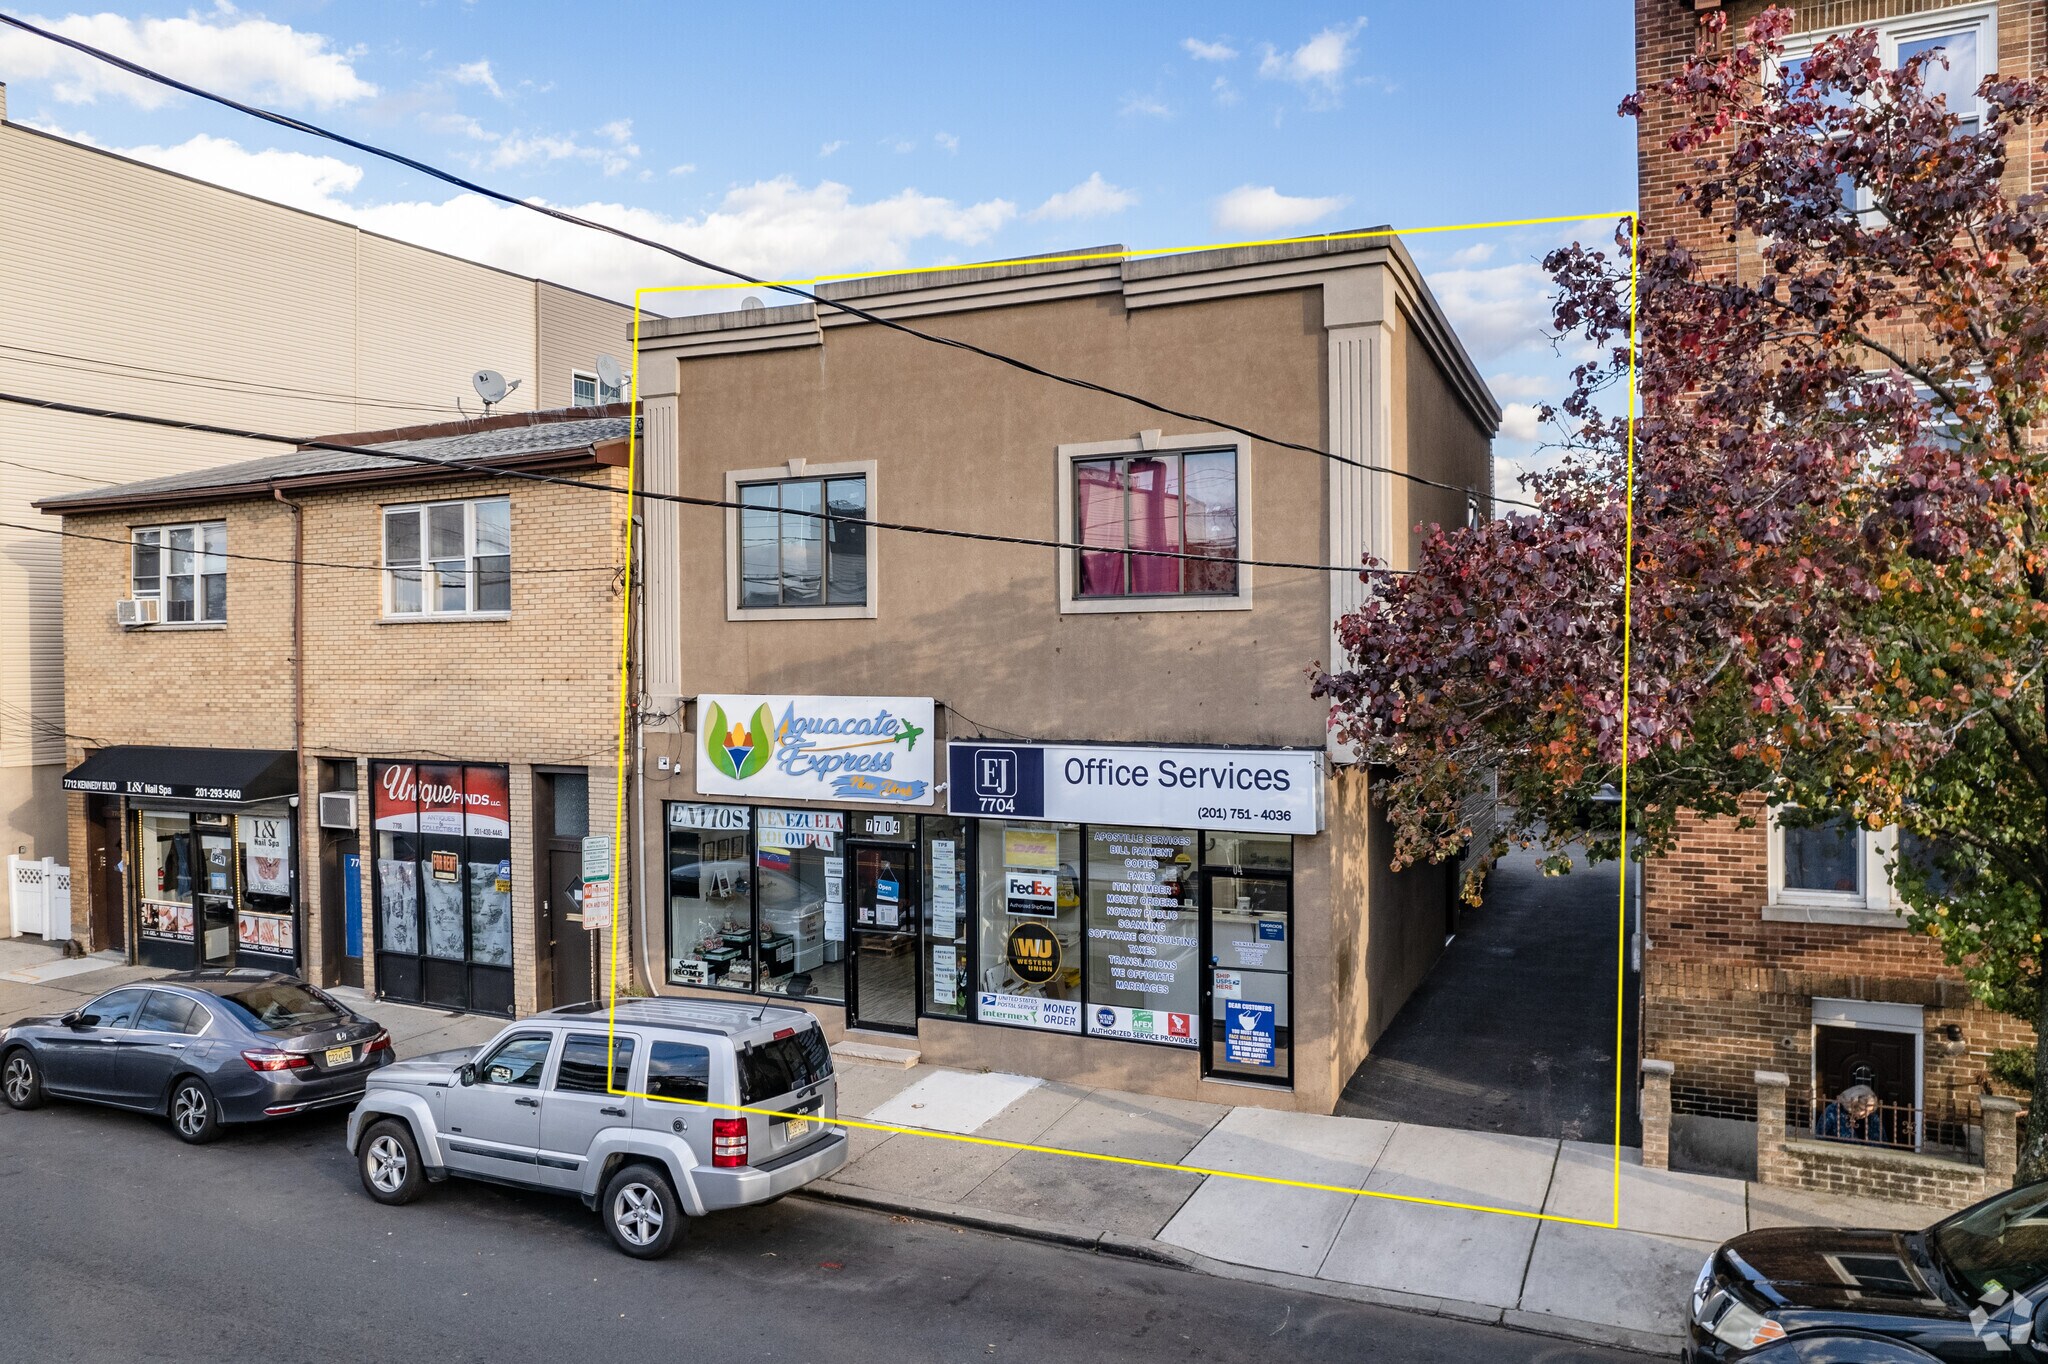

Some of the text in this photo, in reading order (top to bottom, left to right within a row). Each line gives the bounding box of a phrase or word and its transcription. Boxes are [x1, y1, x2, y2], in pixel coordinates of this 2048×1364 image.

[774, 700, 900, 745] Aguacate
[777, 741, 894, 782] Express
[981, 758, 1009, 793] EJ
[1064, 758, 1290, 791] Office Services
[64, 779, 117, 791] 7712 KENNEDY BLVD
[383, 765, 453, 809] Unique
[453, 794, 489, 805] FINDS
[850, 775, 875, 790] New
[145, 784, 157, 794] Nail
[158, 785, 172, 796] Spa
[195, 788, 241, 799] 201-293-5460
[979, 798, 1015, 812] 7704
[427, 814, 455, 822] ANTIQUES
[759, 809, 843, 830] VENEZUELA
[1198, 808, 1227, 821] (201)
[1231, 808, 1251, 820] 751
[1261, 810, 1291, 821] 4036
[422, 824, 461, 833] COLLECTIBLES
[474, 827, 503, 836] 201-430-4445
[866, 819, 900, 833] 7704
[254, 838, 279, 848] Nail Spa
[1094, 832, 1191, 845] APOSTILLE SERVICES
[1110, 845, 1174, 857] BILL PAYMENT
[1125, 858, 1158, 869] COPIES
[1127, 871, 1156, 881] FAXES
[878, 883, 892, 891] Open
[1010, 879, 1052, 896] FedEx
[1112, 882, 1171, 895] ITIN NUMBER
[1107, 894, 1178, 908] MONEY ORDERS
[1107, 907, 1178, 920] NOTARY PUBLIC
[1118, 919, 1166, 931] SCANNING
[1088, 928, 1197, 947] SOFTWARE CONSULTING
[1013, 938, 1052, 958] WU
[1128, 945, 1157, 955] TAXES
[1108, 955, 1177, 970] TRANSLATIONS
[1111, 967, 1174, 982] WE OFFICIATE
[1116, 980, 1169, 994] MARRIAGES
[1043, 1003, 1077, 1015] MONEY
[1242, 1004, 1272, 1012] CUSTOMERS
[983, 1009, 1029, 1021] intermex
[1044, 1014, 1076, 1026] ORDER
[1133, 1020, 1153, 1028] AFEX
[1091, 1027, 1198, 1044] AUTHORIZED SERVICE PROVIDERS
